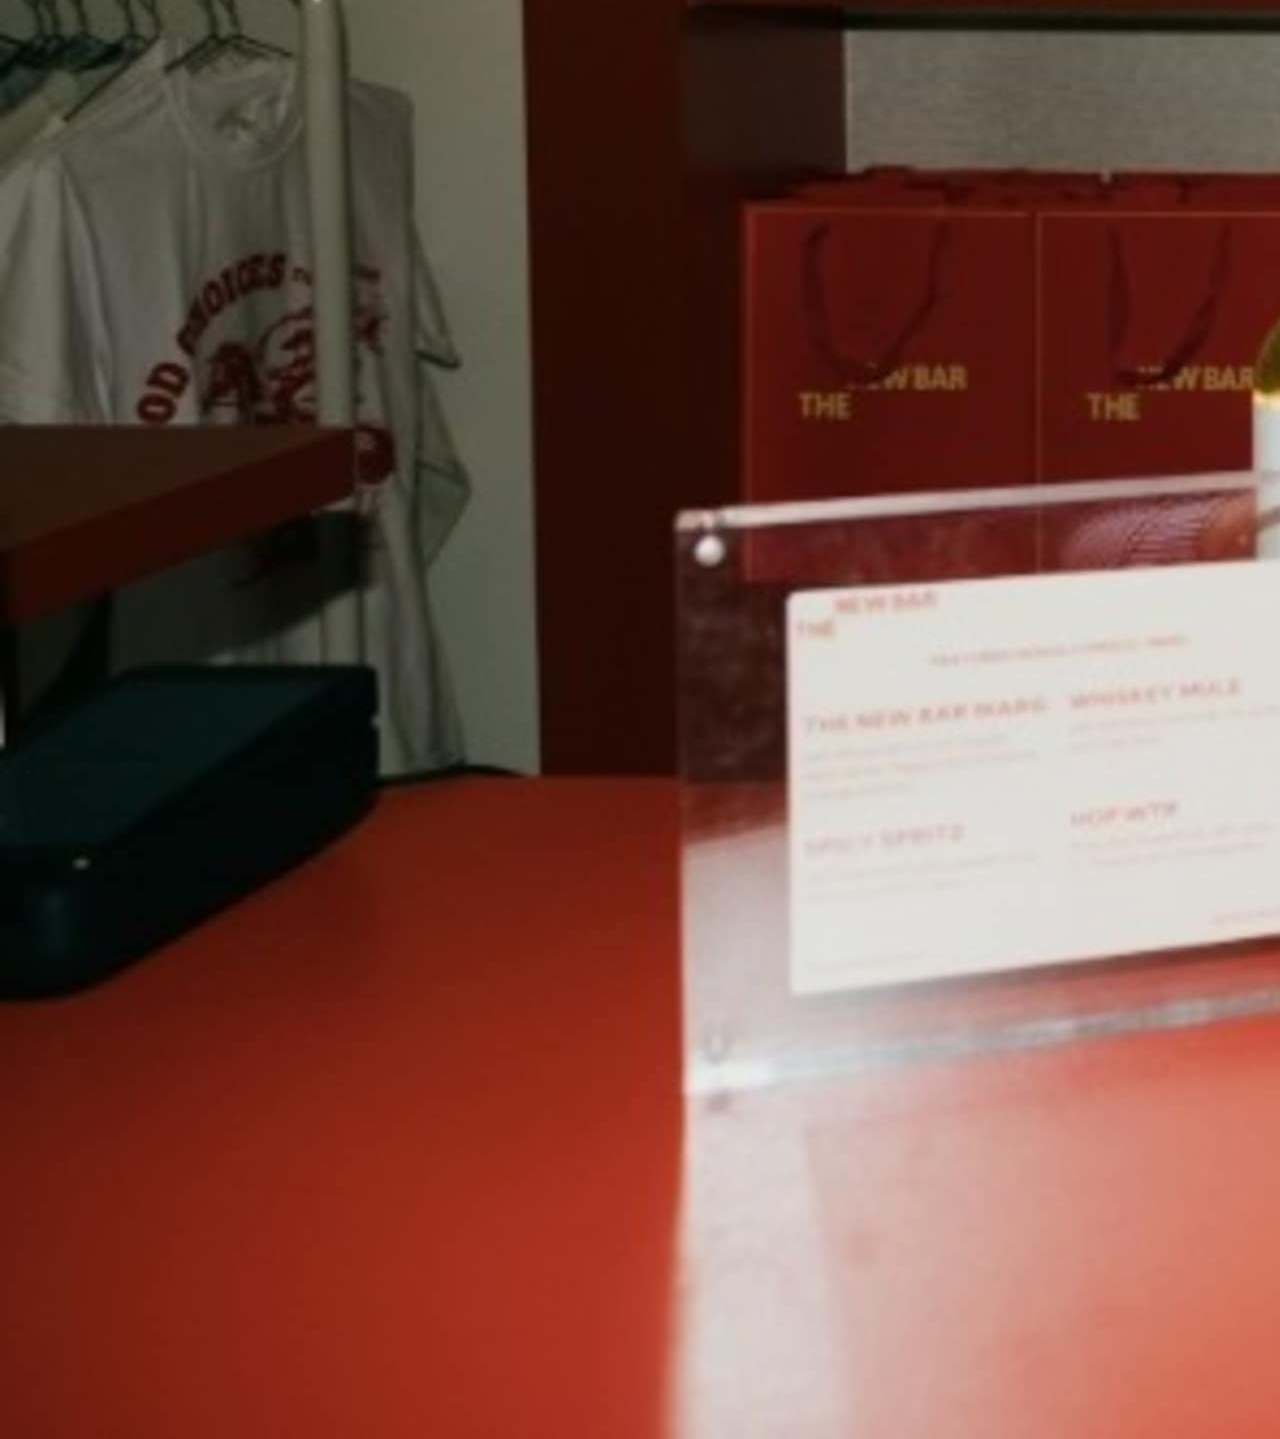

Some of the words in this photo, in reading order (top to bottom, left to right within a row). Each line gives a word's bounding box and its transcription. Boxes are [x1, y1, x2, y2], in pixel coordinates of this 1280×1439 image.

[799, 392, 852, 420] THE
[913, 366, 967, 391] BAR
[1088, 392, 1140, 421] THE
[1204, 366, 1255, 391] BAR
[834, 595, 886, 613] NEW
